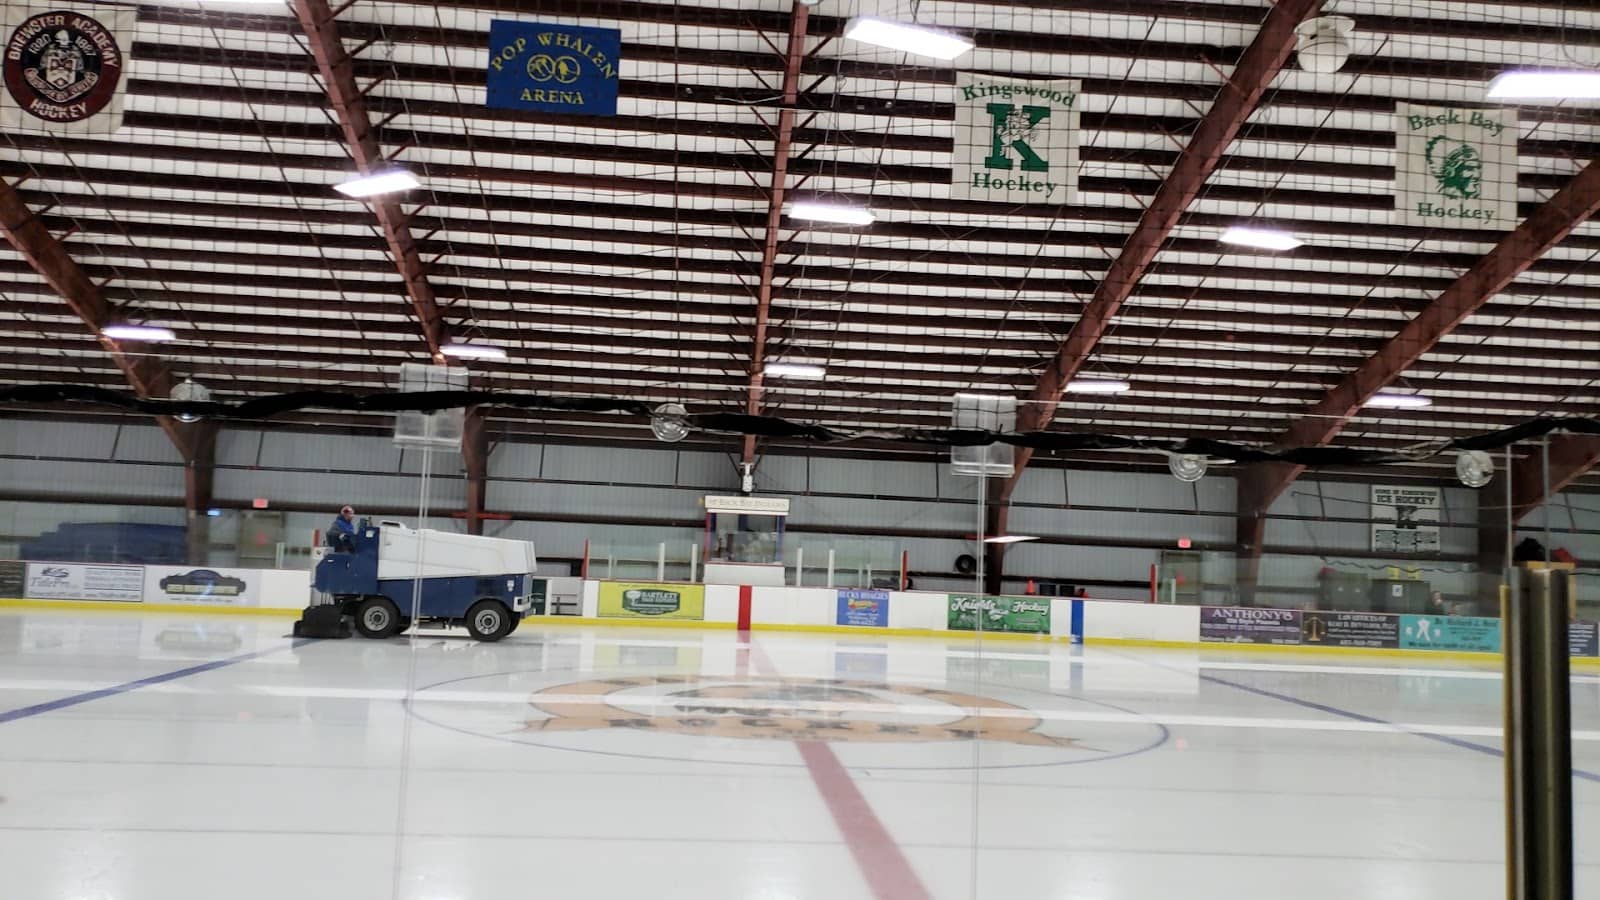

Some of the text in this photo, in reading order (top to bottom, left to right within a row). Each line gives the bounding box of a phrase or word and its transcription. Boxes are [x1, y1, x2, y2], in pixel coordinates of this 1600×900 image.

[8, 15, 119, 68] BREWSTER ACADEMY
[491, 32, 617, 80] POP WHALEN
[520, 88, 585, 105] ARENA
[962, 81, 1076, 107] Kingswood
[29, 98, 88, 119] HOCKEY
[1408, 109, 1506, 137] Back Bay
[972, 172, 1057, 198] Hockey
[1416, 202, 1496, 224] Hockey
